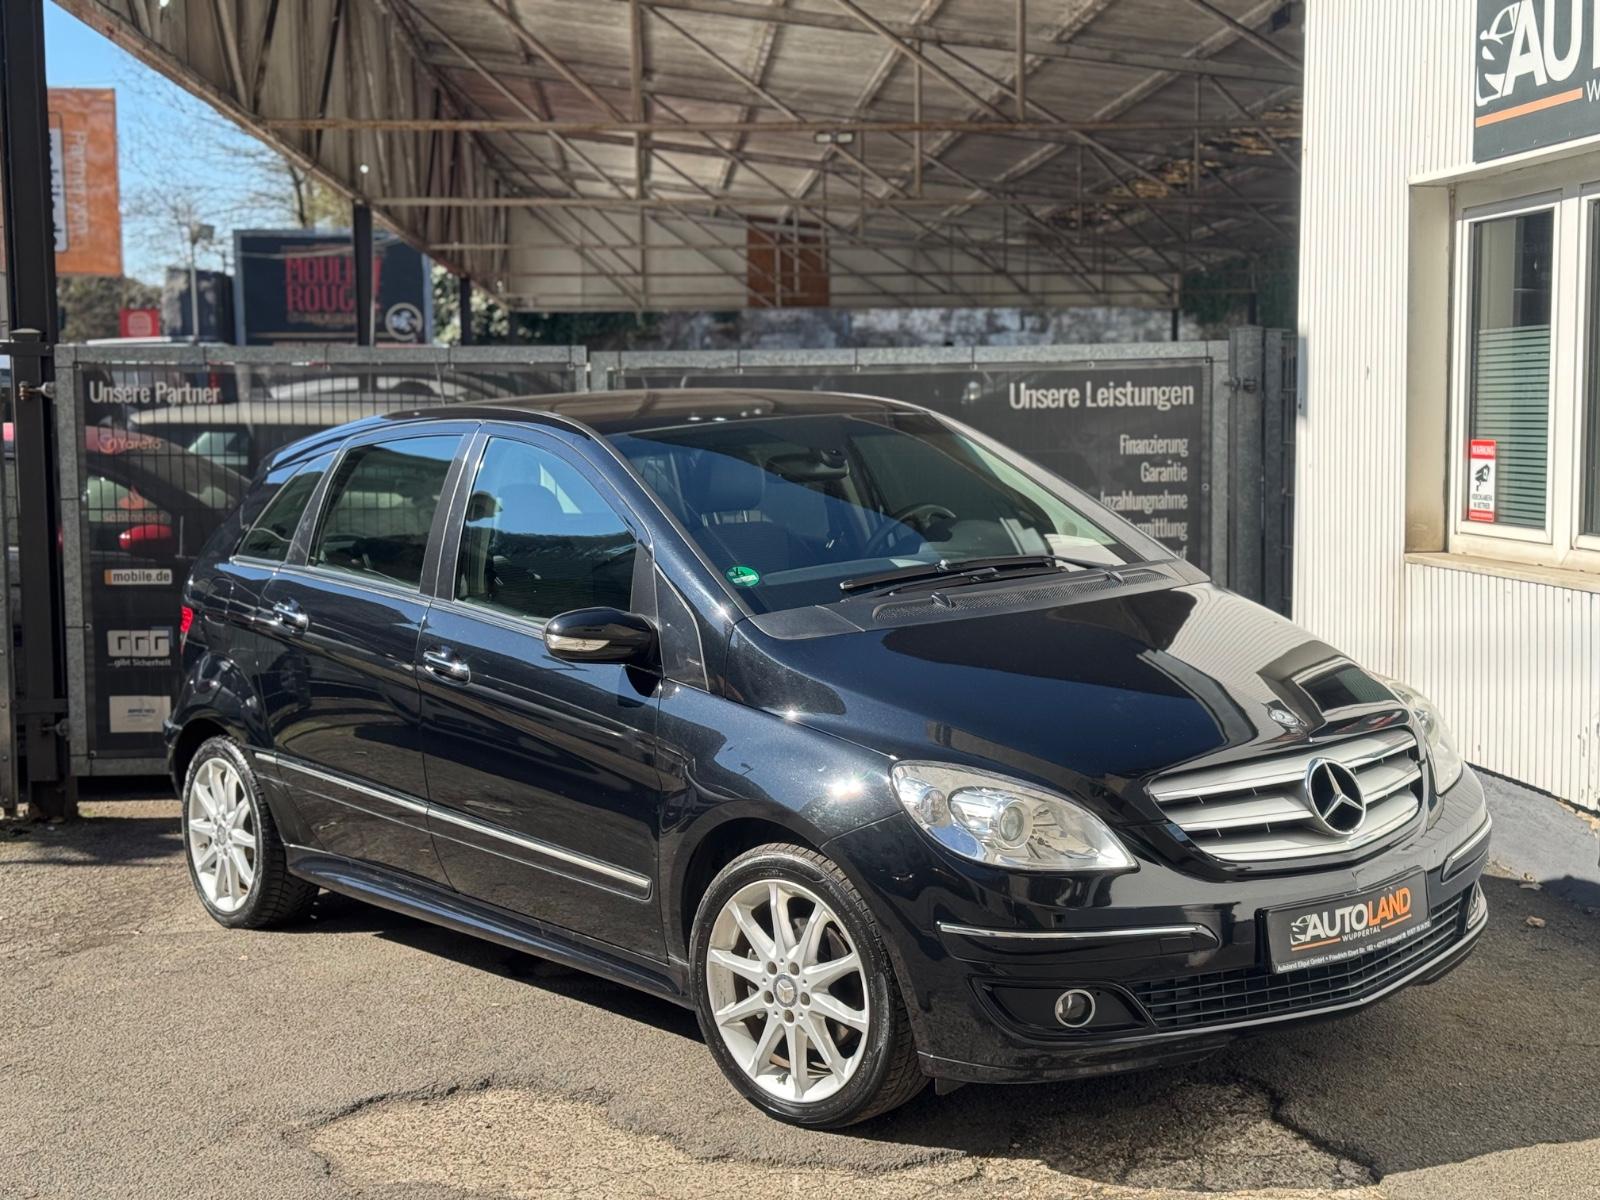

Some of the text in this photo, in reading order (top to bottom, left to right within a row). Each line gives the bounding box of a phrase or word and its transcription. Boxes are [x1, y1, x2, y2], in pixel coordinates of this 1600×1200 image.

[286, 255, 353, 286] MOULI
[89, 380, 220, 405] Unsere Partner
[1009, 380, 1194, 411] Unsere Leistungen
[1119, 433, 1189, 457] Finanzierung
[1140, 459, 1188, 483] Garantie
[113, 570, 170, 583] mobile.de
[1305, 887, 1411, 942] AUTOLAND
[1341, 925, 1381, 942] WUPPERTAL
